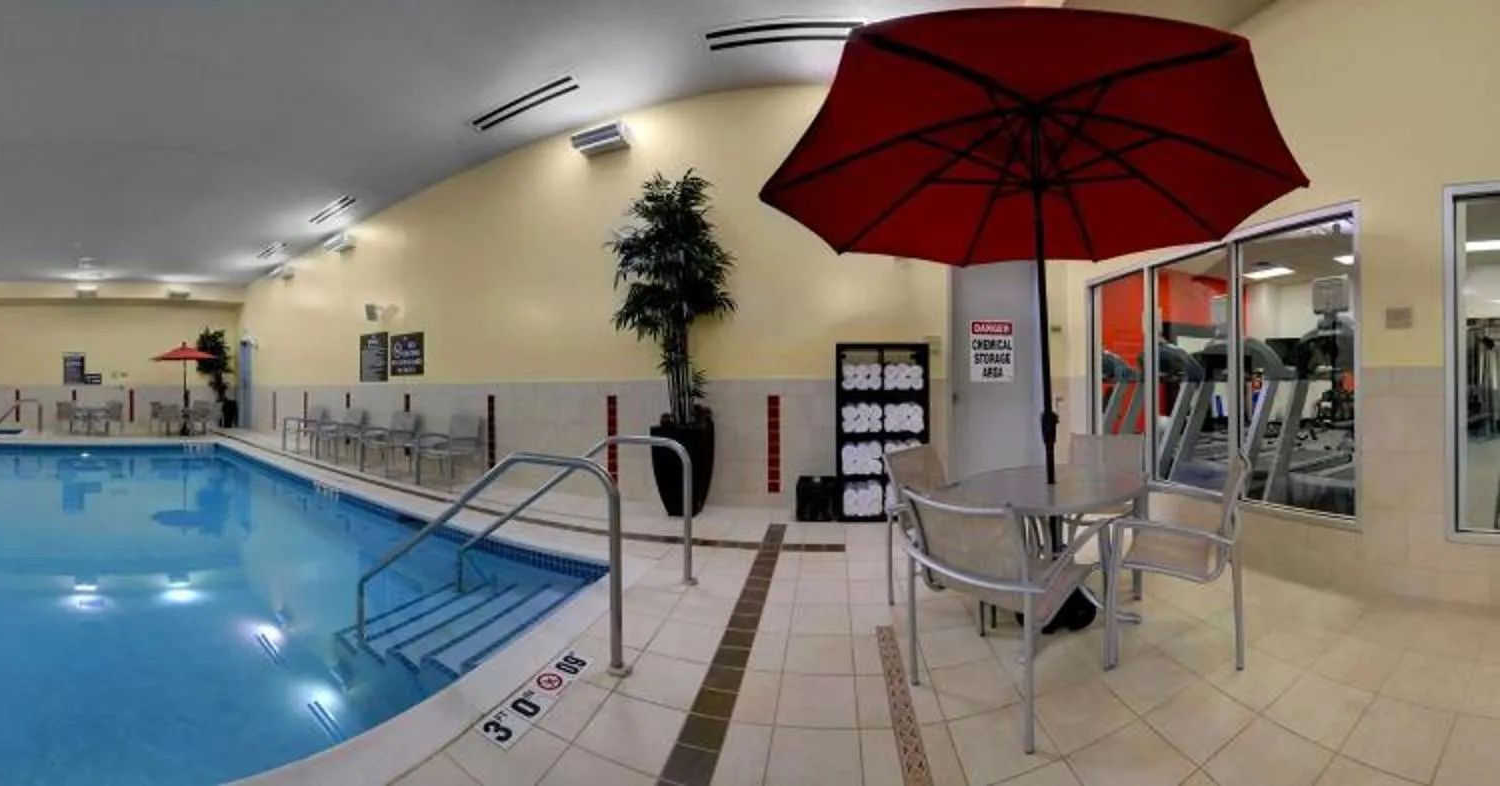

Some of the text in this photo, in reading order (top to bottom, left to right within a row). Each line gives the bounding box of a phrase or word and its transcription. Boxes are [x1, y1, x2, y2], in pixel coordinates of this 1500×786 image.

[973, 323, 1010, 333] DANGER
[972, 339, 1012, 350] CHEMICAL
[974, 353, 1011, 364] STORAGE
[982, 367, 1003, 378] AREA
[483, 720, 513, 743] 3
[511, 697, 541, 719] 0
